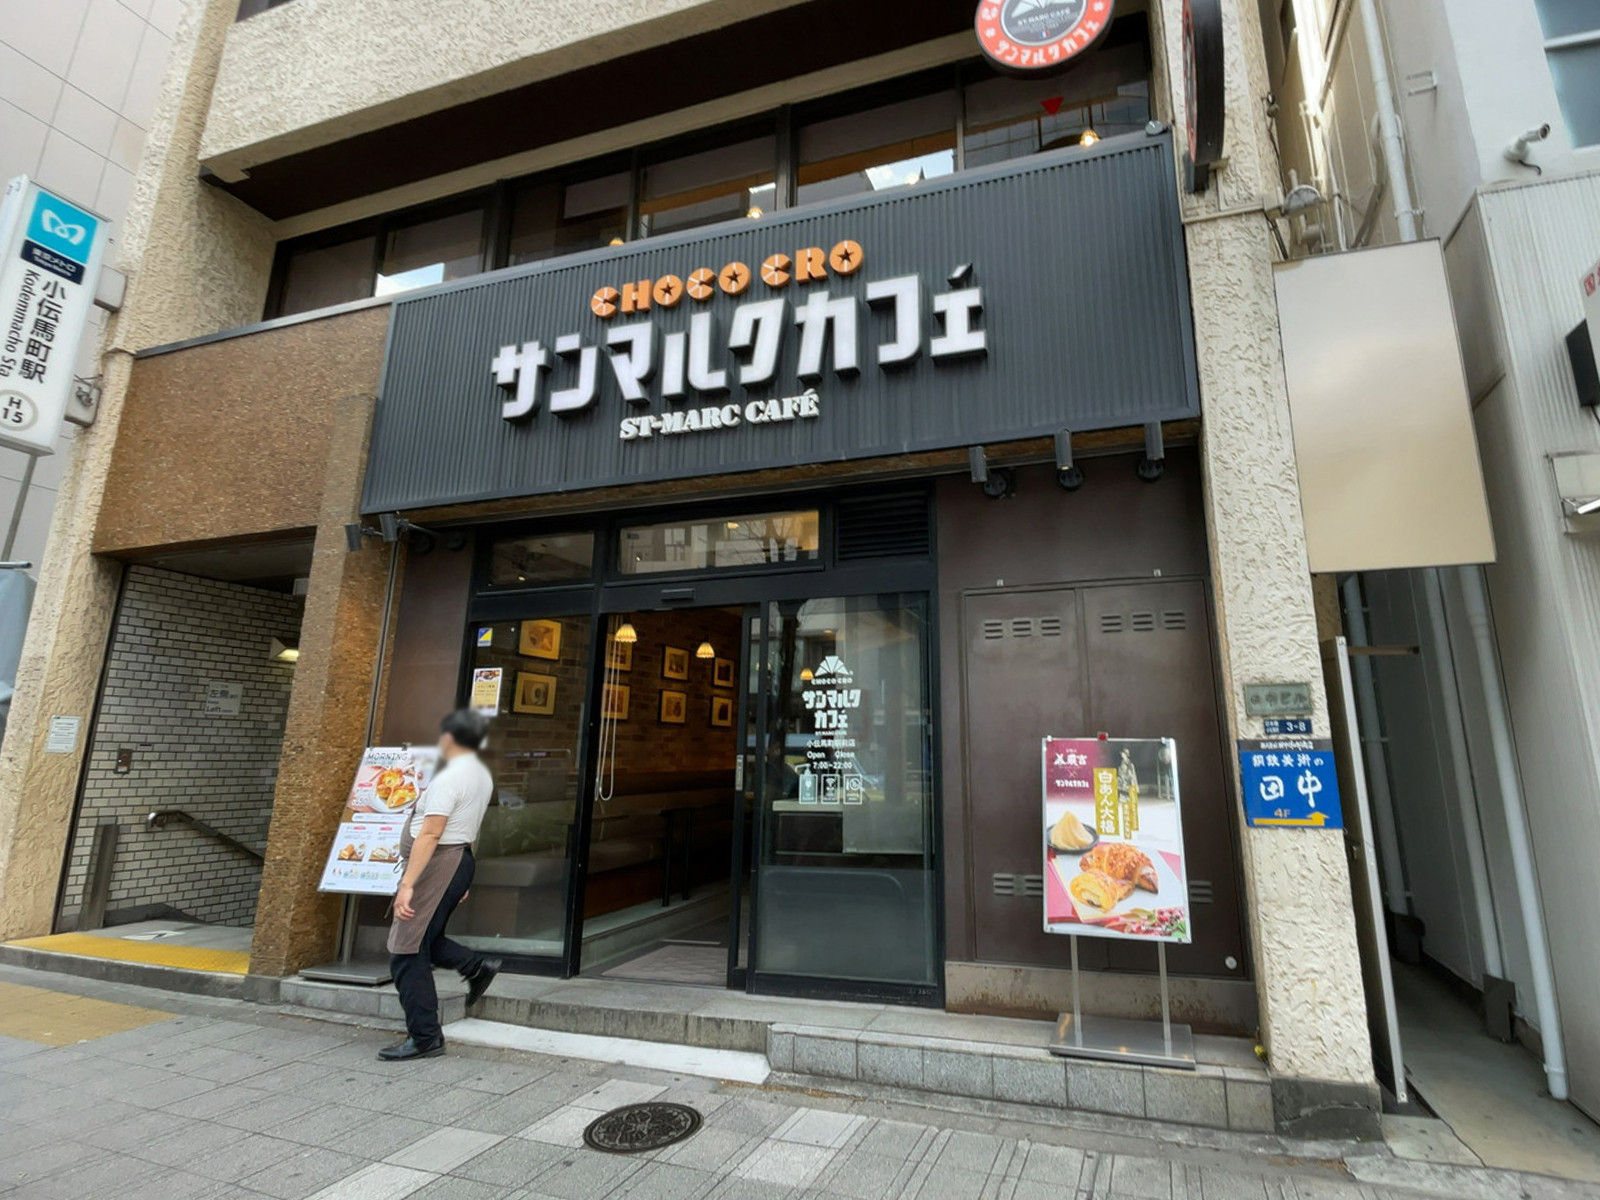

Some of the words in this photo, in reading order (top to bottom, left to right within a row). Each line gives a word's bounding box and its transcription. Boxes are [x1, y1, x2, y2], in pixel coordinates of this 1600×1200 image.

[994, 19, 1100, 65] サンマルクカフェ
[591, 261, 752, 318] CHOCO
[760, 239, 864, 288] CRO
[5, 269, 41, 354] Kodemmacho
[19, 280, 66, 384] 小伝馬町駅
[491, 262, 990, 421] サンマルクカフェ
[9, 396, 22, 409] H
[3, 407, 23, 424] 15
[620, 404, 741, 440] ST-MARC
[744, 387, 821, 421] CAFÉ
[811, 677, 837, 685] CHOCO
[802, 688, 862, 709] サンマルク
[814, 710, 848, 729] カフェ
[1286, 721, 1307, 732] 3-8
[366, 752, 409, 762] MORNING
[807, 751, 826, 760] Open
[1259, 769, 1323, 808] 田中
[1097, 771, 1117, 834] 白あん大福
[1273, 807, 1291, 817] 4F
